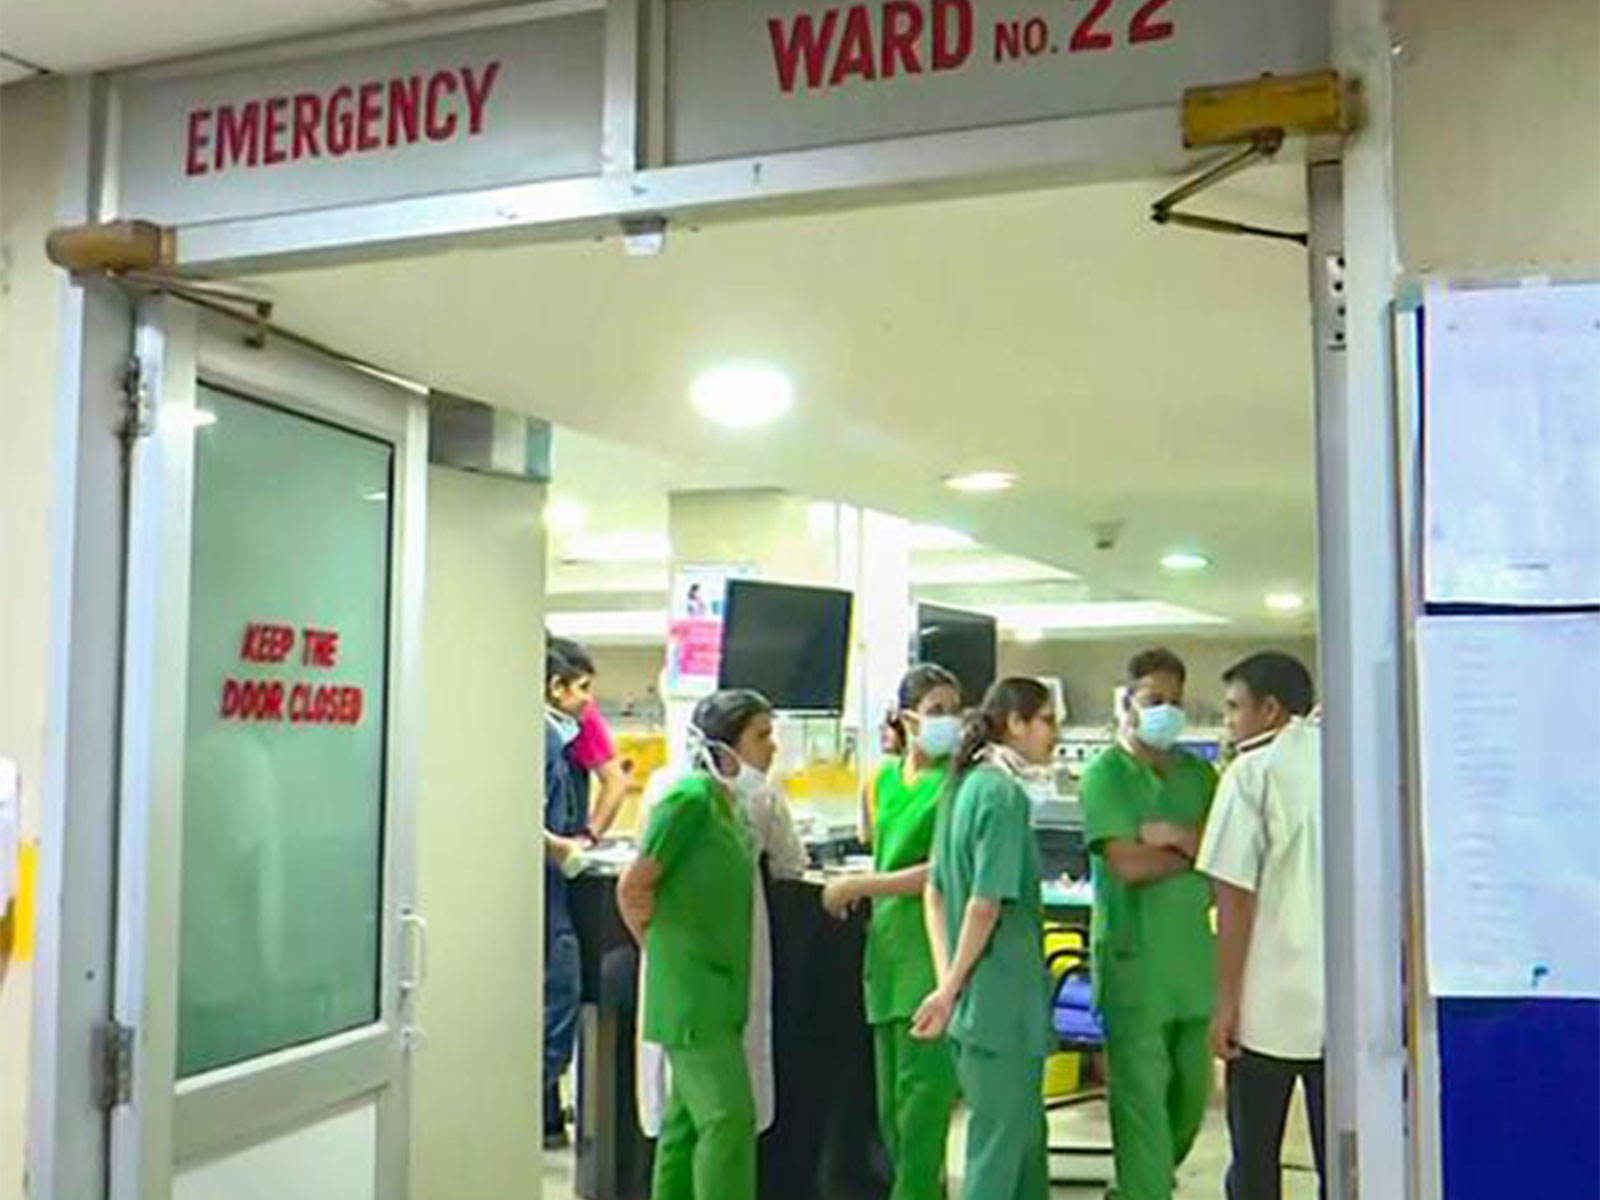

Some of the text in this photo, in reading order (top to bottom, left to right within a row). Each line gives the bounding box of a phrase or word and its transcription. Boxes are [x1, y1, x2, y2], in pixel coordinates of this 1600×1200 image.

[768, 0, 974, 92] WARD
[995, 17, 1058, 62] NO.
[185, 61, 500, 176] EMERGENCY
[241, 622, 338, 666] KEEP THE
[221, 677, 363, 724] DOOR CLOSED
